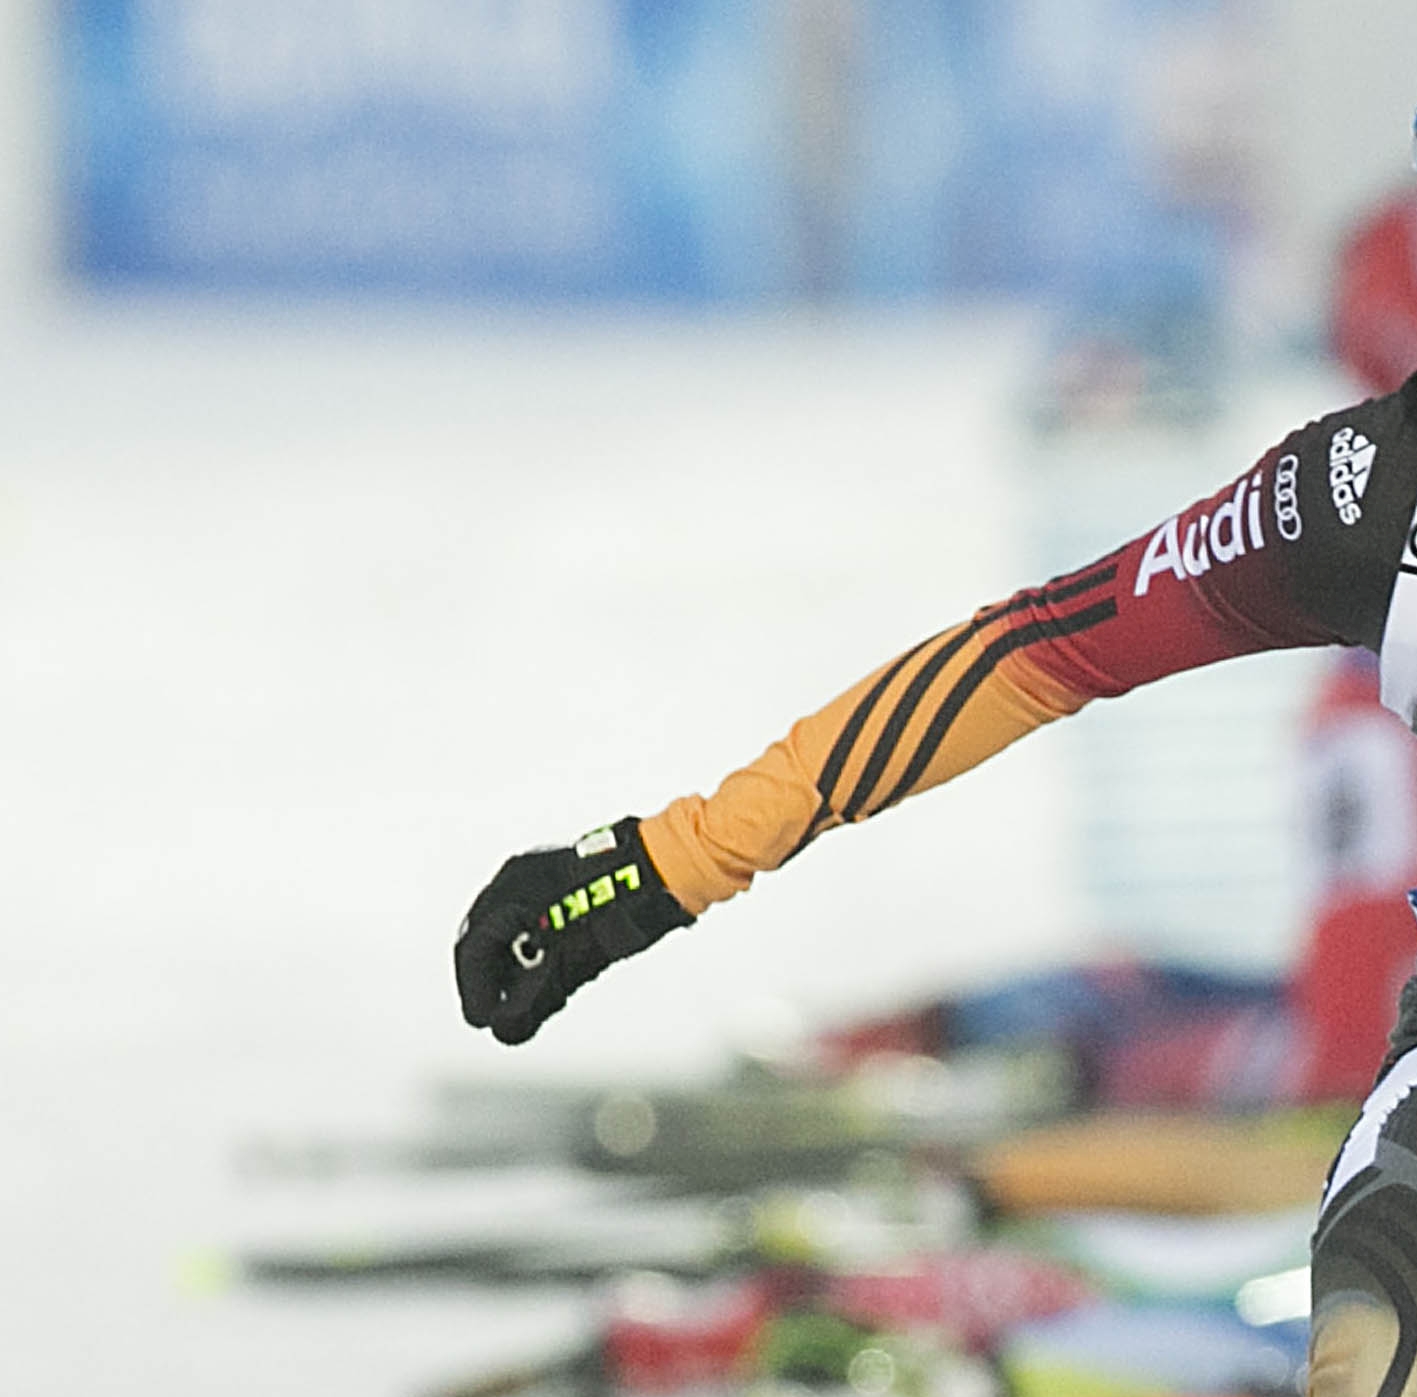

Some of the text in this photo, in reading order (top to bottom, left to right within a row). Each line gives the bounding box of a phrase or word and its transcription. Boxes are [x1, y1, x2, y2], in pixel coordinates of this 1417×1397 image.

[1329, 427, 1362, 526] adidas
[1133, 470, 1266, 597] Audi
[550, 864, 641, 930] LEKI
